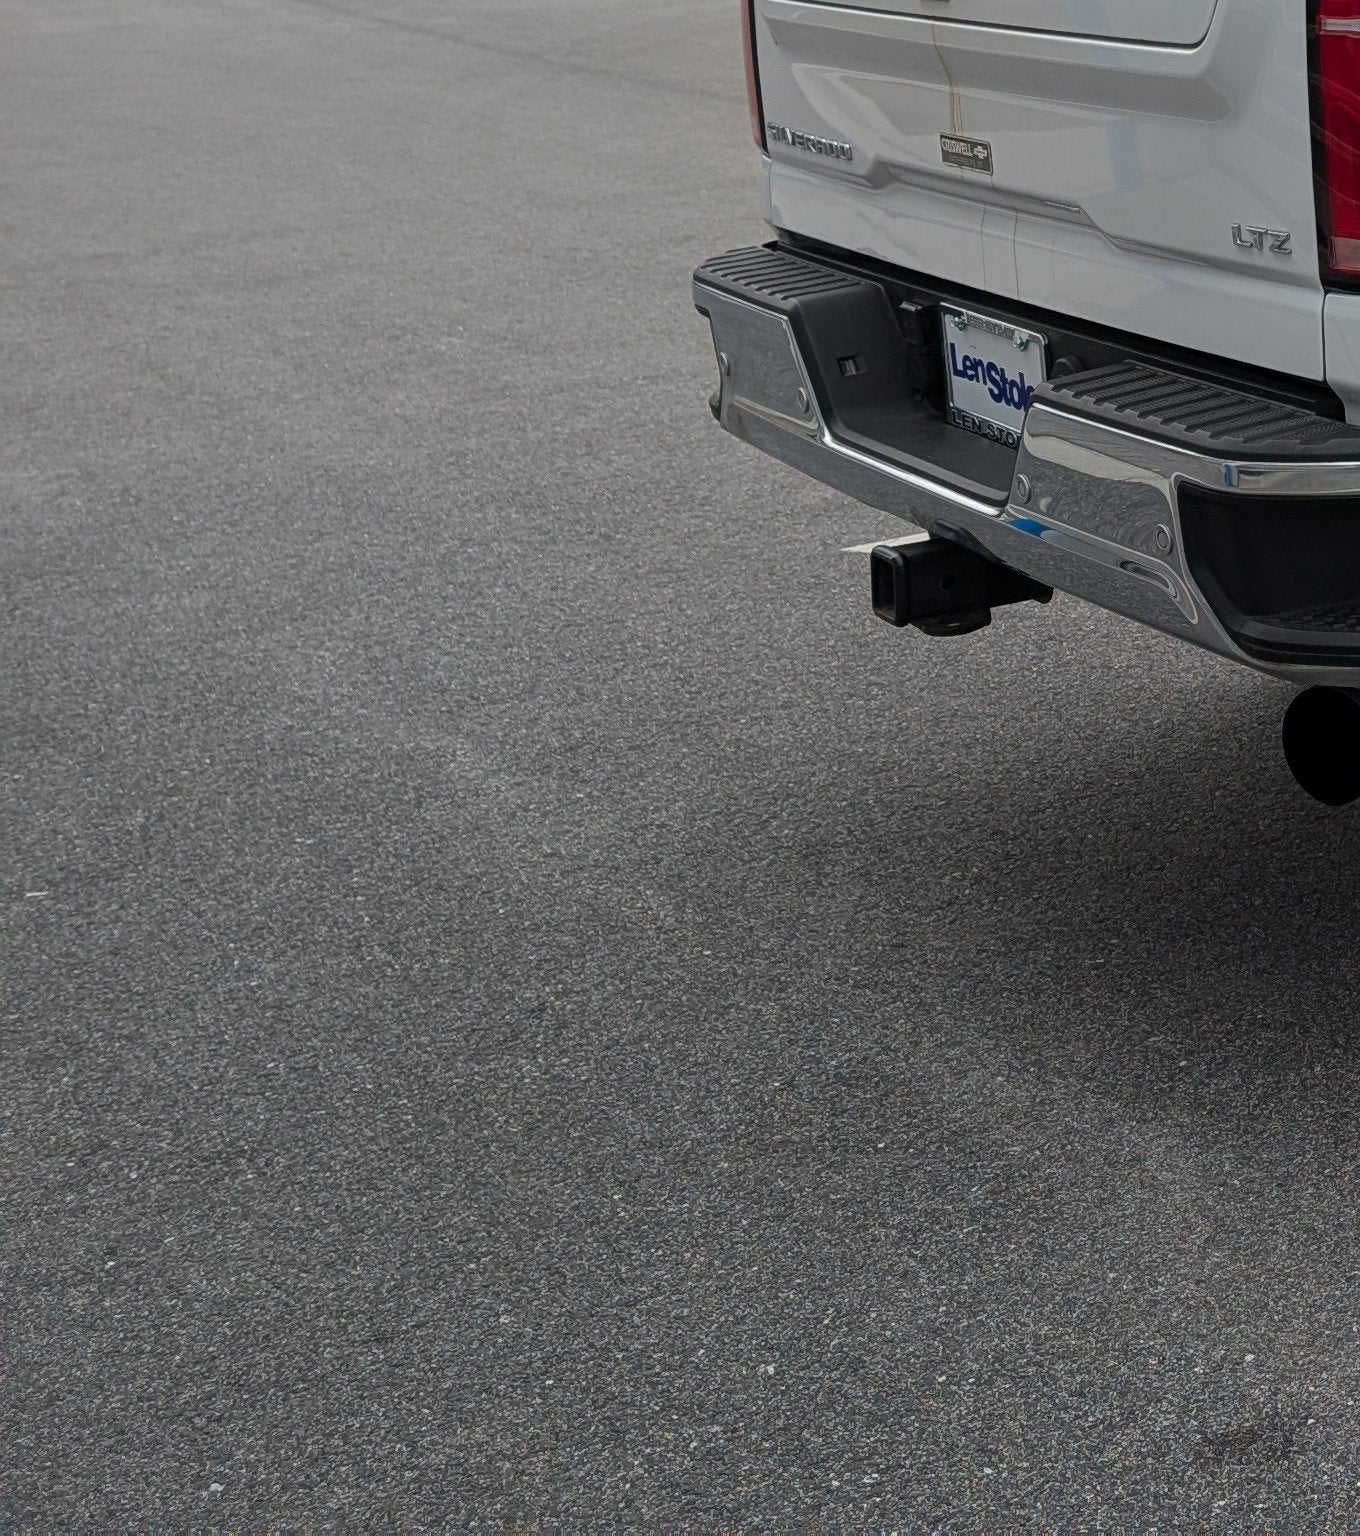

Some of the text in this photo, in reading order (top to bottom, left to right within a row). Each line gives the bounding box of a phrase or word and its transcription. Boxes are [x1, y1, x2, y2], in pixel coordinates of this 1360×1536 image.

[767, 120, 853, 162] SILVERADO
[1230, 222, 1293, 256] LTZ
[951, 409, 1020, 448] LEN STO
